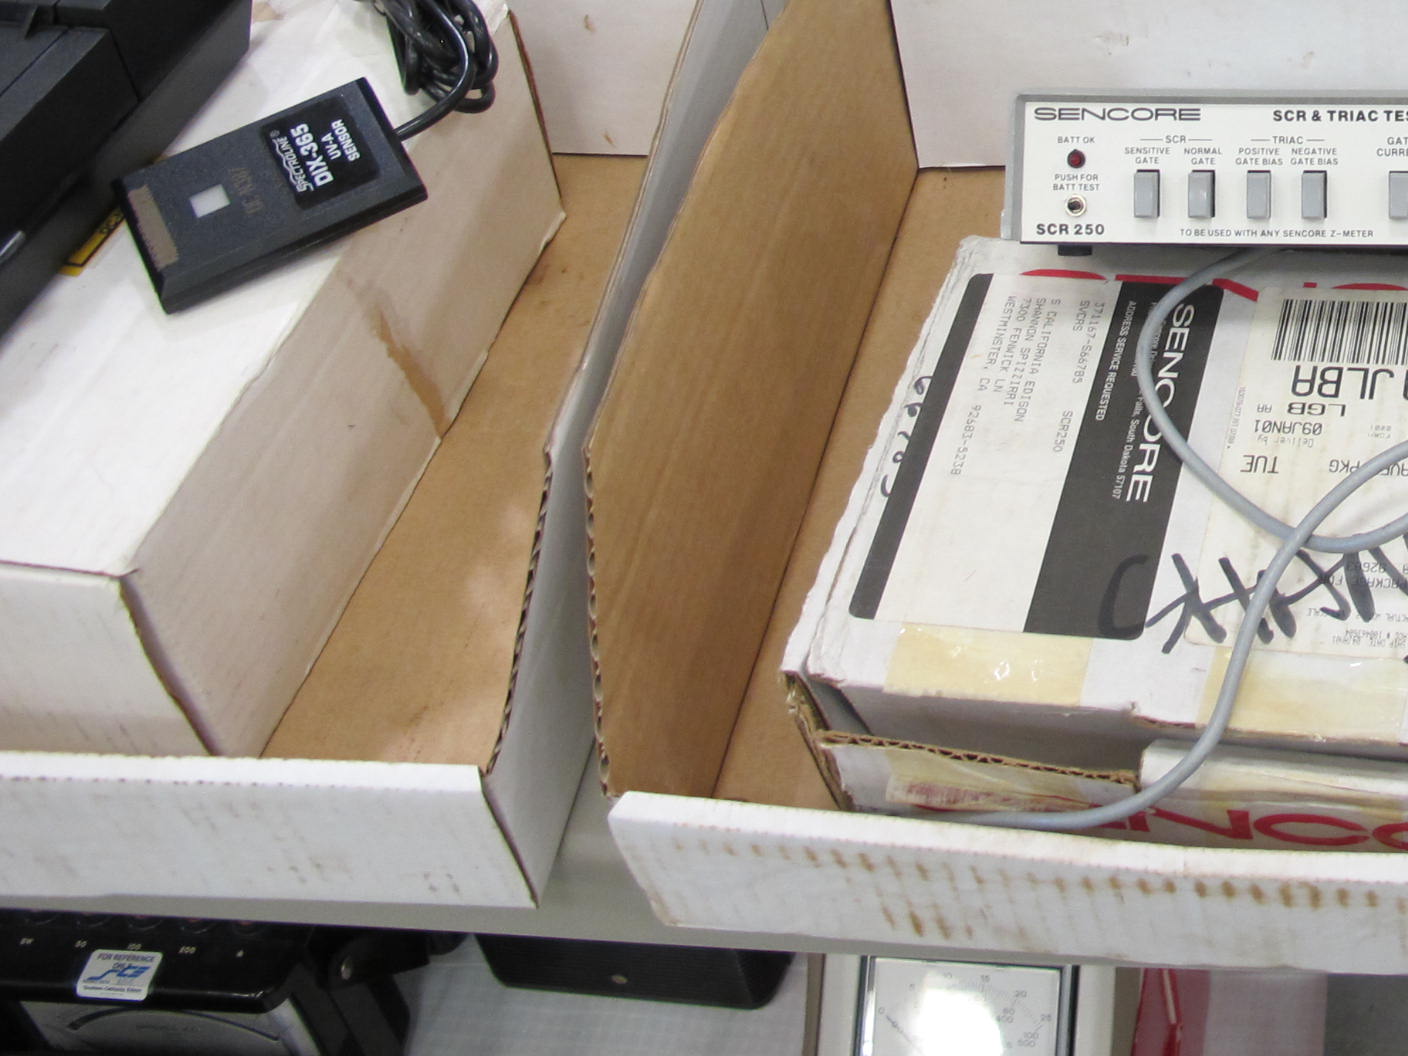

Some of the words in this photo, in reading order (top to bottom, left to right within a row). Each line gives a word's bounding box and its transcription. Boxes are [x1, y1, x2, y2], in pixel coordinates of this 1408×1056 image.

[1034, 107, 1201, 121] SENCORE
[1273, 110, 1306, 122] SCR
[1311, 110, 1322, 122] &
[1327, 110, 1379, 122] TRIAC
[331, 119, 360, 162] SENSOR
[1057, 136, 1081, 144] BATT
[1082, 136, 1095, 144] OK
[1165, 135, 1186, 143] SCR
[1272, 136, 1304, 144] TRIAC
[321, 133, 342, 160] UV-A
[1124, 147, 1171, 155] SENSITIVE
[1184, 147, 1222, 155] NORMAL
[1238, 147, 1280, 155] POSITIVE
[1291, 147, 1337, 155] NEGATIVE
[290, 123, 334, 186] DIX-365
[1135, 157, 1159, 165] GATE
[1191, 157, 1216, 165] GATE
[1054, 174, 1077, 182] PUSH
[1080, 174, 1098, 182] FOR
[1036, 224, 1069, 235] SCR
[1074, 224, 1105, 235] 250
[1330, 230, 1374, 238] Z-METER
[1025, 298, 1047, 341] SHANNON
[1000, 328, 1021, 373] FENWICK
[1030, 312, 1057, 375] CALIFORNIA
[1109, 337, 1127, 371] SERVICE
[977, 377, 991, 392] CA
[994, 380, 1002, 393] LN
[1290, 365, 1395, 400] JLBA
[1014, 381, 1036, 422] EDISON
[1096, 372, 1118, 421] REQUESTED
[1256, 403, 1272, 413] AA
[1287, 401, 1347, 417] LGB
[1053, 410, 1073, 452] SCR250
[1254, 419, 1323, 435] 09JAN01
[1240, 455, 1279, 473] TUE
